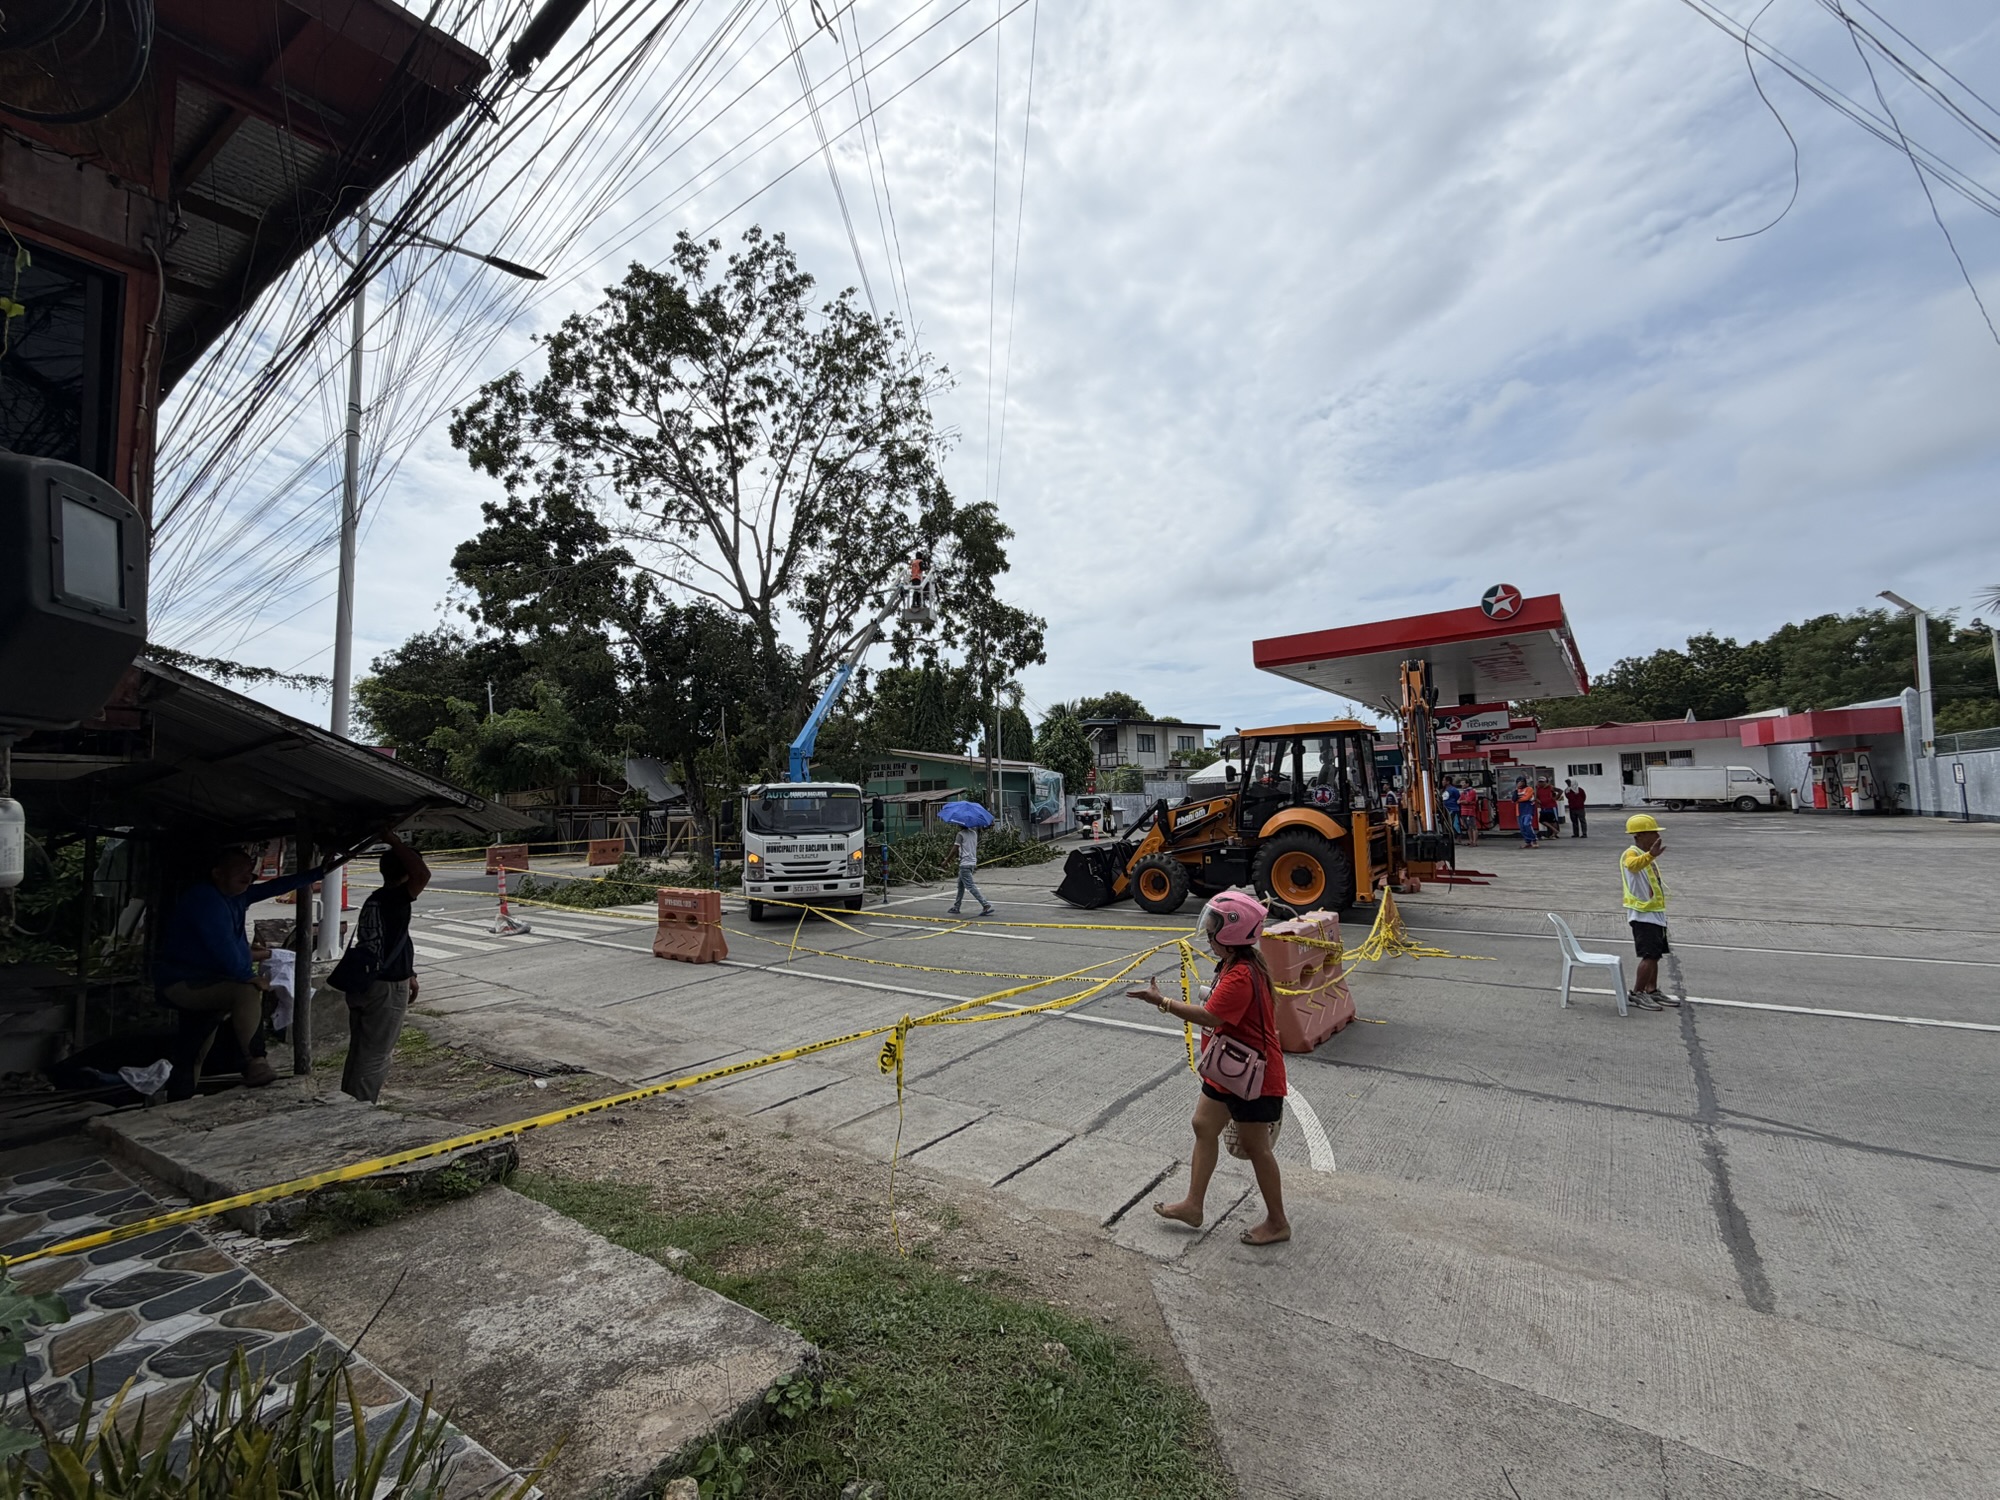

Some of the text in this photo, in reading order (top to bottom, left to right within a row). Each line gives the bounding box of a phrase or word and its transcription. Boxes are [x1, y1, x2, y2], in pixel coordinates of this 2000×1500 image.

[1466, 720, 1498, 729] TECHRON
[766, 845, 798, 853] MUNICIPALITY
[799, 844, 805, 852] OF
[830, 843, 846, 851] BOHOL
